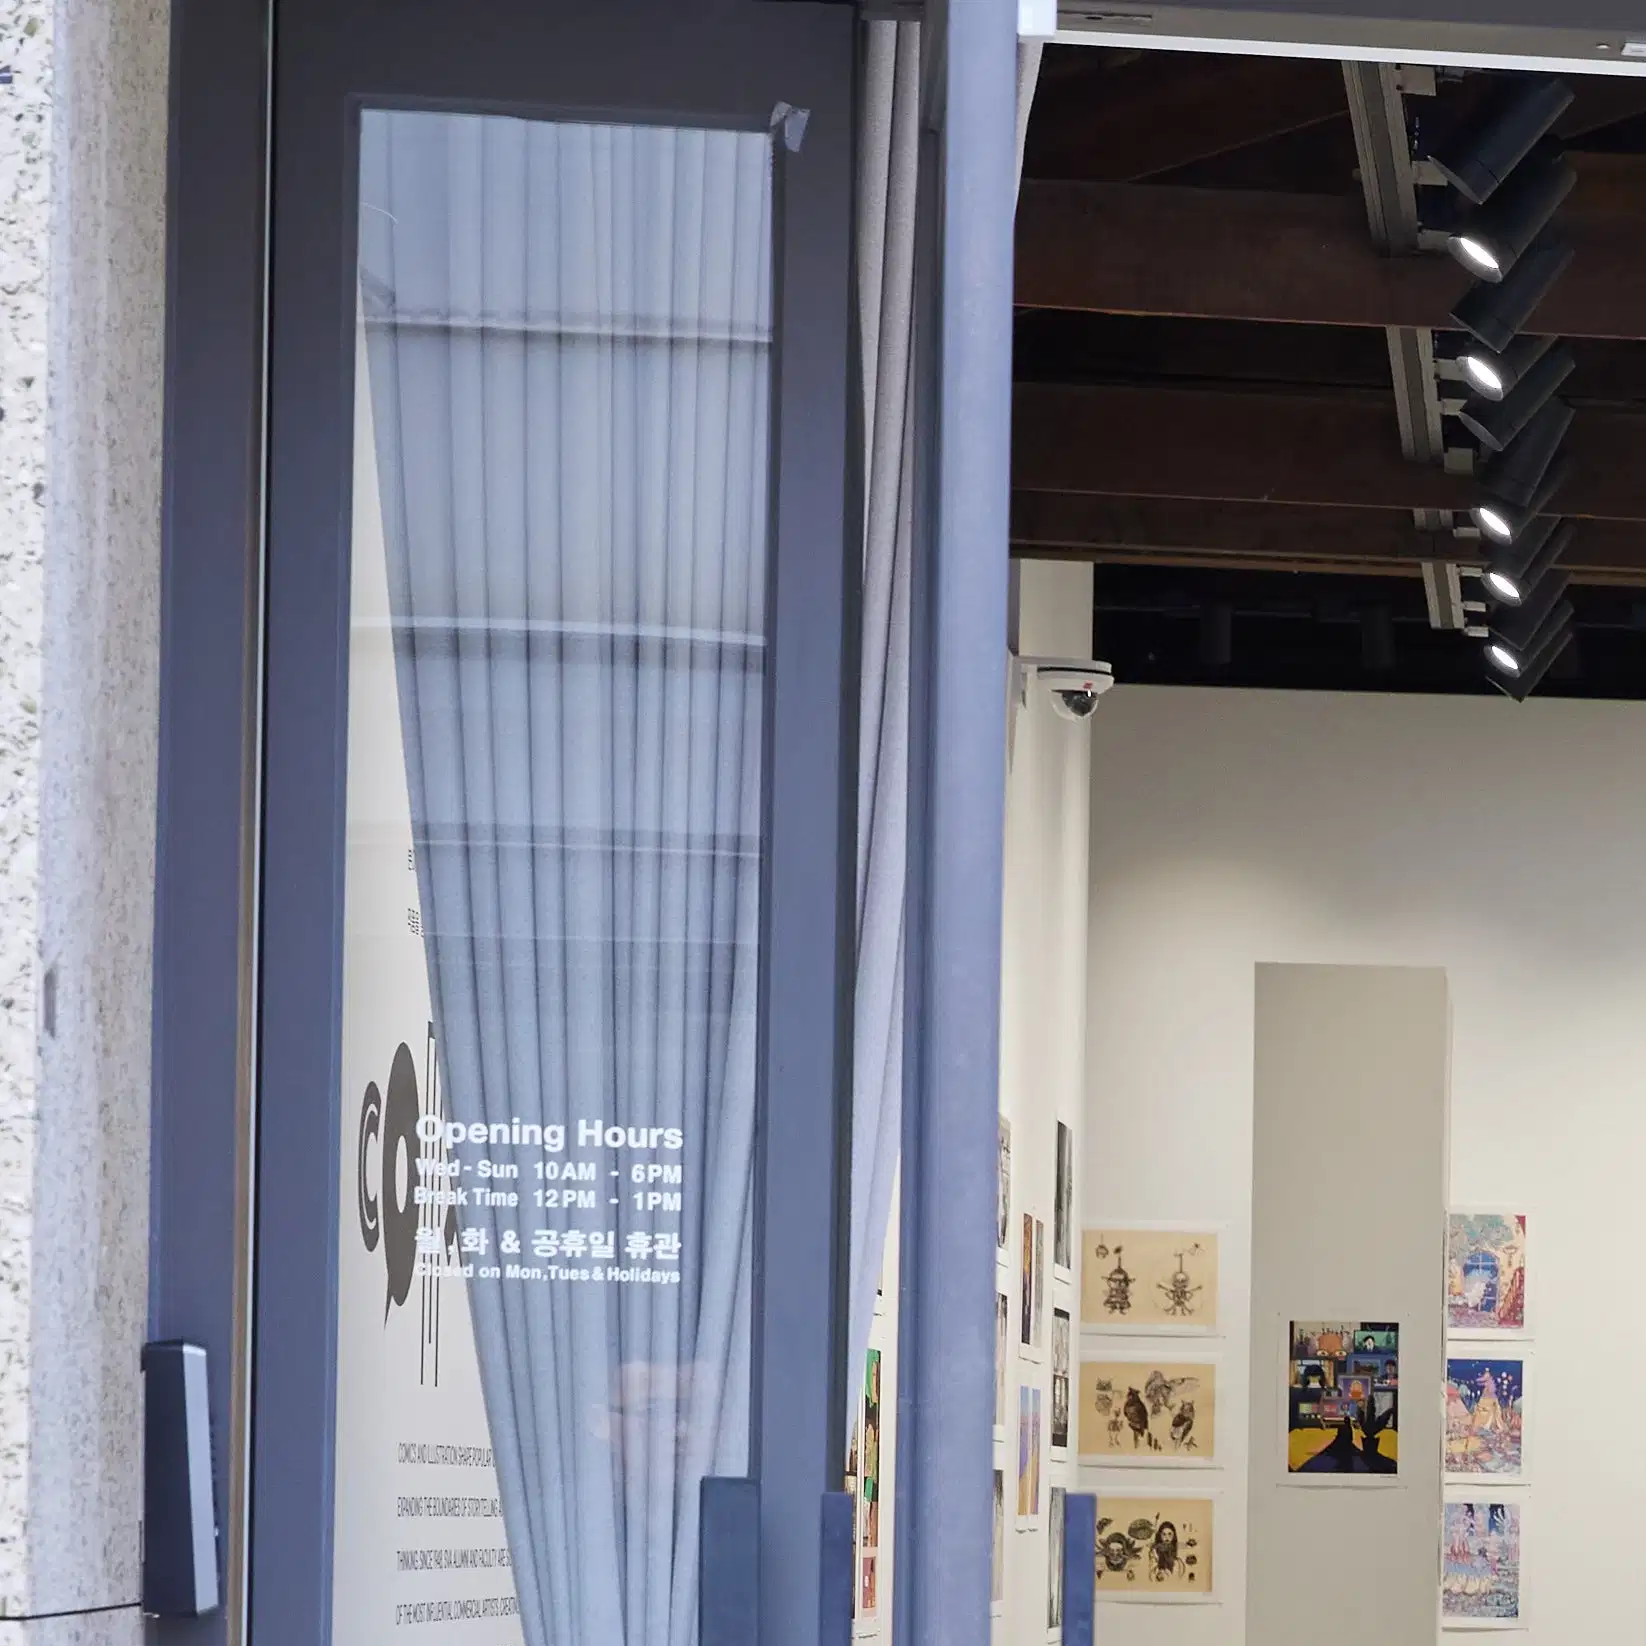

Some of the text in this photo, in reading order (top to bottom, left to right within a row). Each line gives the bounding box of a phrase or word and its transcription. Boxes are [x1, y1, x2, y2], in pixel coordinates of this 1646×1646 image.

[416, 1114, 684, 1152] Opening Hours
[415, 1157, 460, 1177] Wed
[477, 1159, 519, 1178] Sun
[414, 1185, 468, 1206] Break
[472, 1187, 519, 1207] Time
[500, 1230, 521, 1254] &
[531, 1229, 615, 1259] 공휴일
[625, 1231, 682, 1260] 휴관
[479, 1266, 501, 1279] on
[607, 1266, 681, 1284] Holidays
